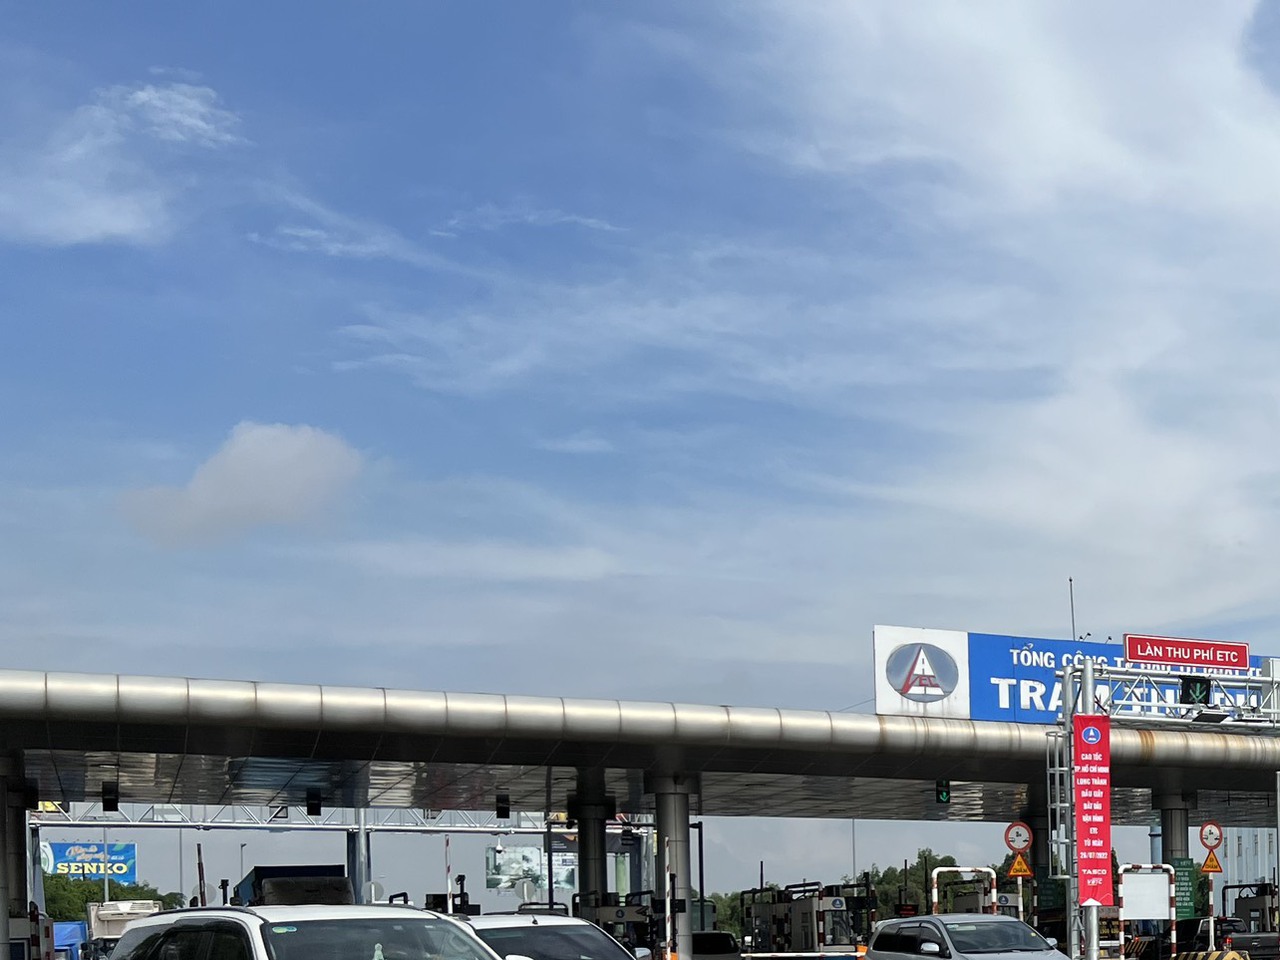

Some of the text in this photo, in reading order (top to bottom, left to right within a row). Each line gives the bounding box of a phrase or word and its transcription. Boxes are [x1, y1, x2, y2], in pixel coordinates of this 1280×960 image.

[1010, 643, 1055, 668] TỔNG
[1137, 642, 1239, 663] LÀN THU PHÍ ETC
[56, 862, 128, 874] SENKO
